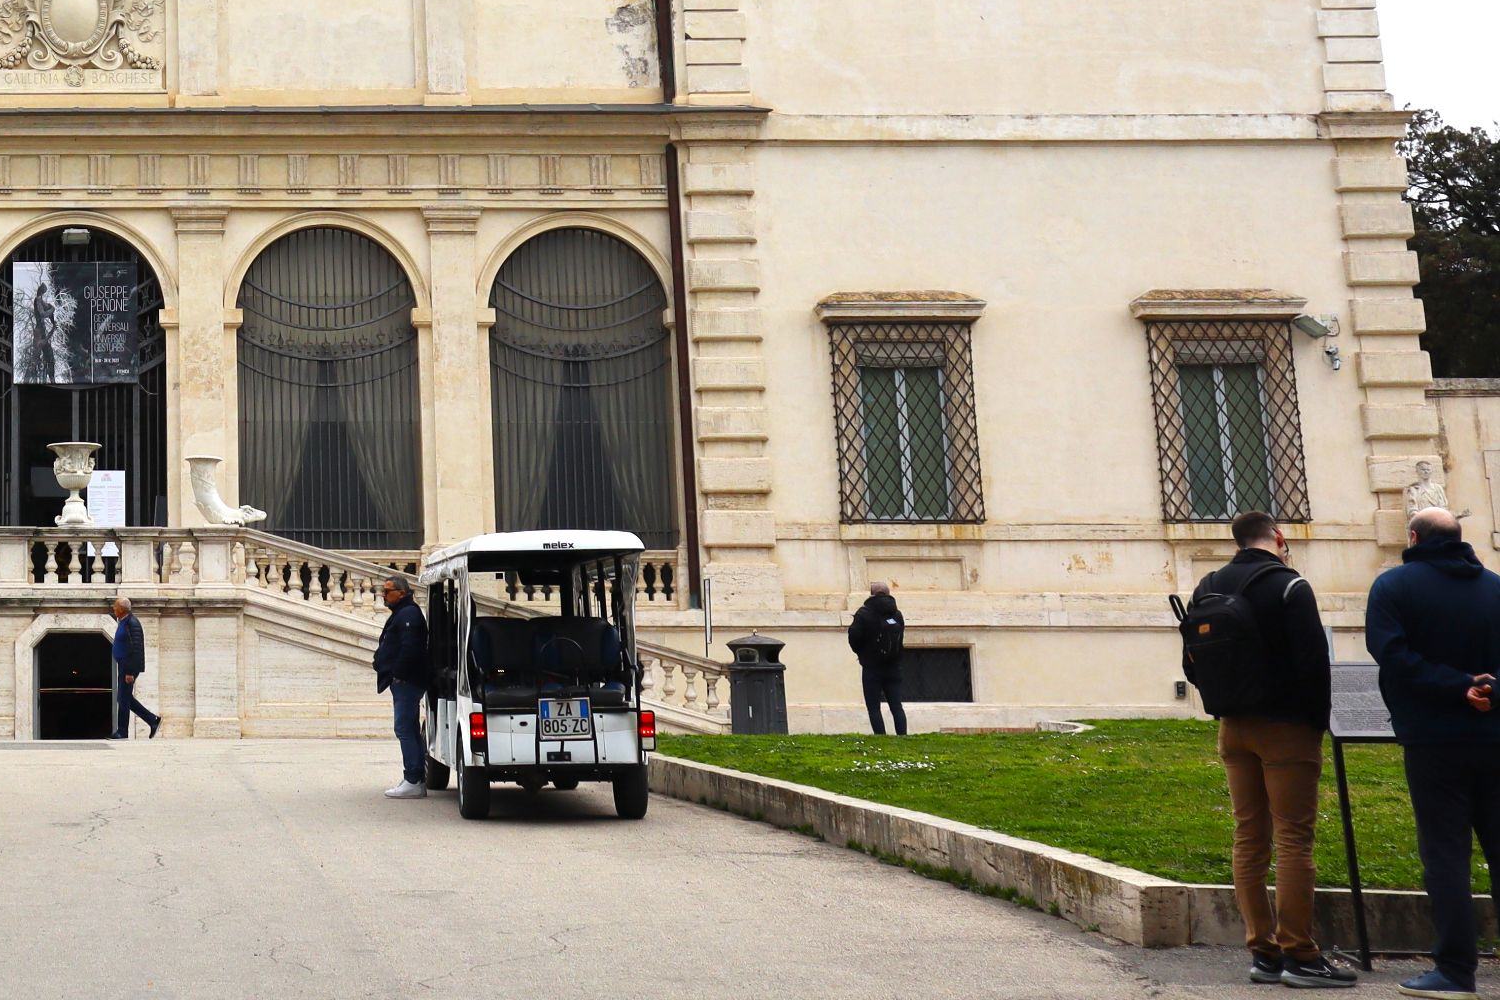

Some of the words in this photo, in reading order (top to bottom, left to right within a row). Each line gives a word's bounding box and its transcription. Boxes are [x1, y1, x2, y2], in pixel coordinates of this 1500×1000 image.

[4, 72, 60, 85] GALLERIA
[91, 72, 156, 85] BORGHESE
[83, 285, 129, 299] GIUSEPPE
[91, 298, 129, 312] PENONE
[93, 342, 125, 353] GESTURES
[542, 541, 575, 550] melex
[556, 702, 573, 717] ZA
